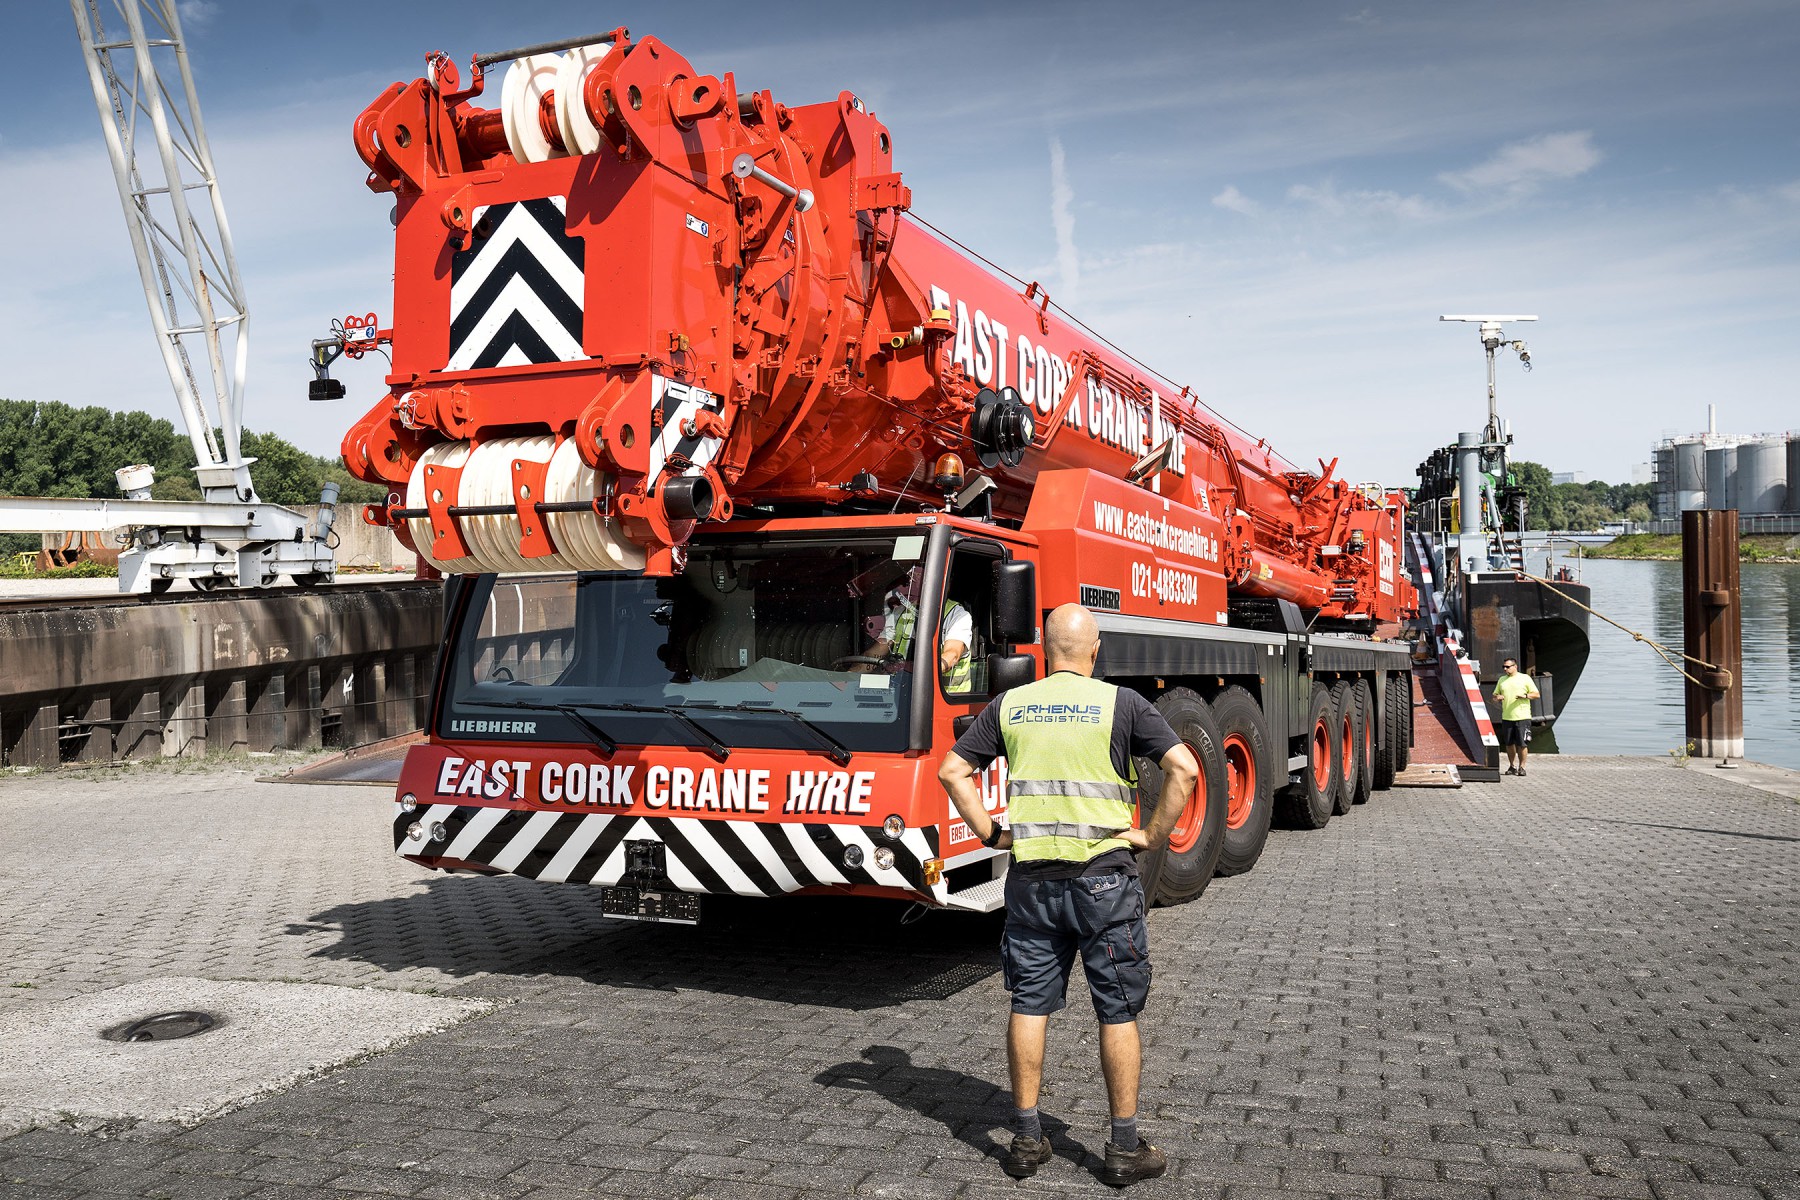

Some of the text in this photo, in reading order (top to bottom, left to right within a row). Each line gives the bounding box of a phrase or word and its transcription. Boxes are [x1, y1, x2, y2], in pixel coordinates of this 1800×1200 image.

[1086, 373, 1148, 458] CRANE
[1093, 500, 1218, 563] www.eastcorkcranehire.ie
[1080, 585, 1120, 610] LIEBHERR
[1131, 561, 1198, 606] 021-4883304
[451, 719, 537, 734] LIEBHERR
[1025, 714, 1101, 724] LOGISTICS
[1026, 703, 1102, 715] RHENUS
[437, 756, 876, 814] EAST CORK CRANE HIRE
